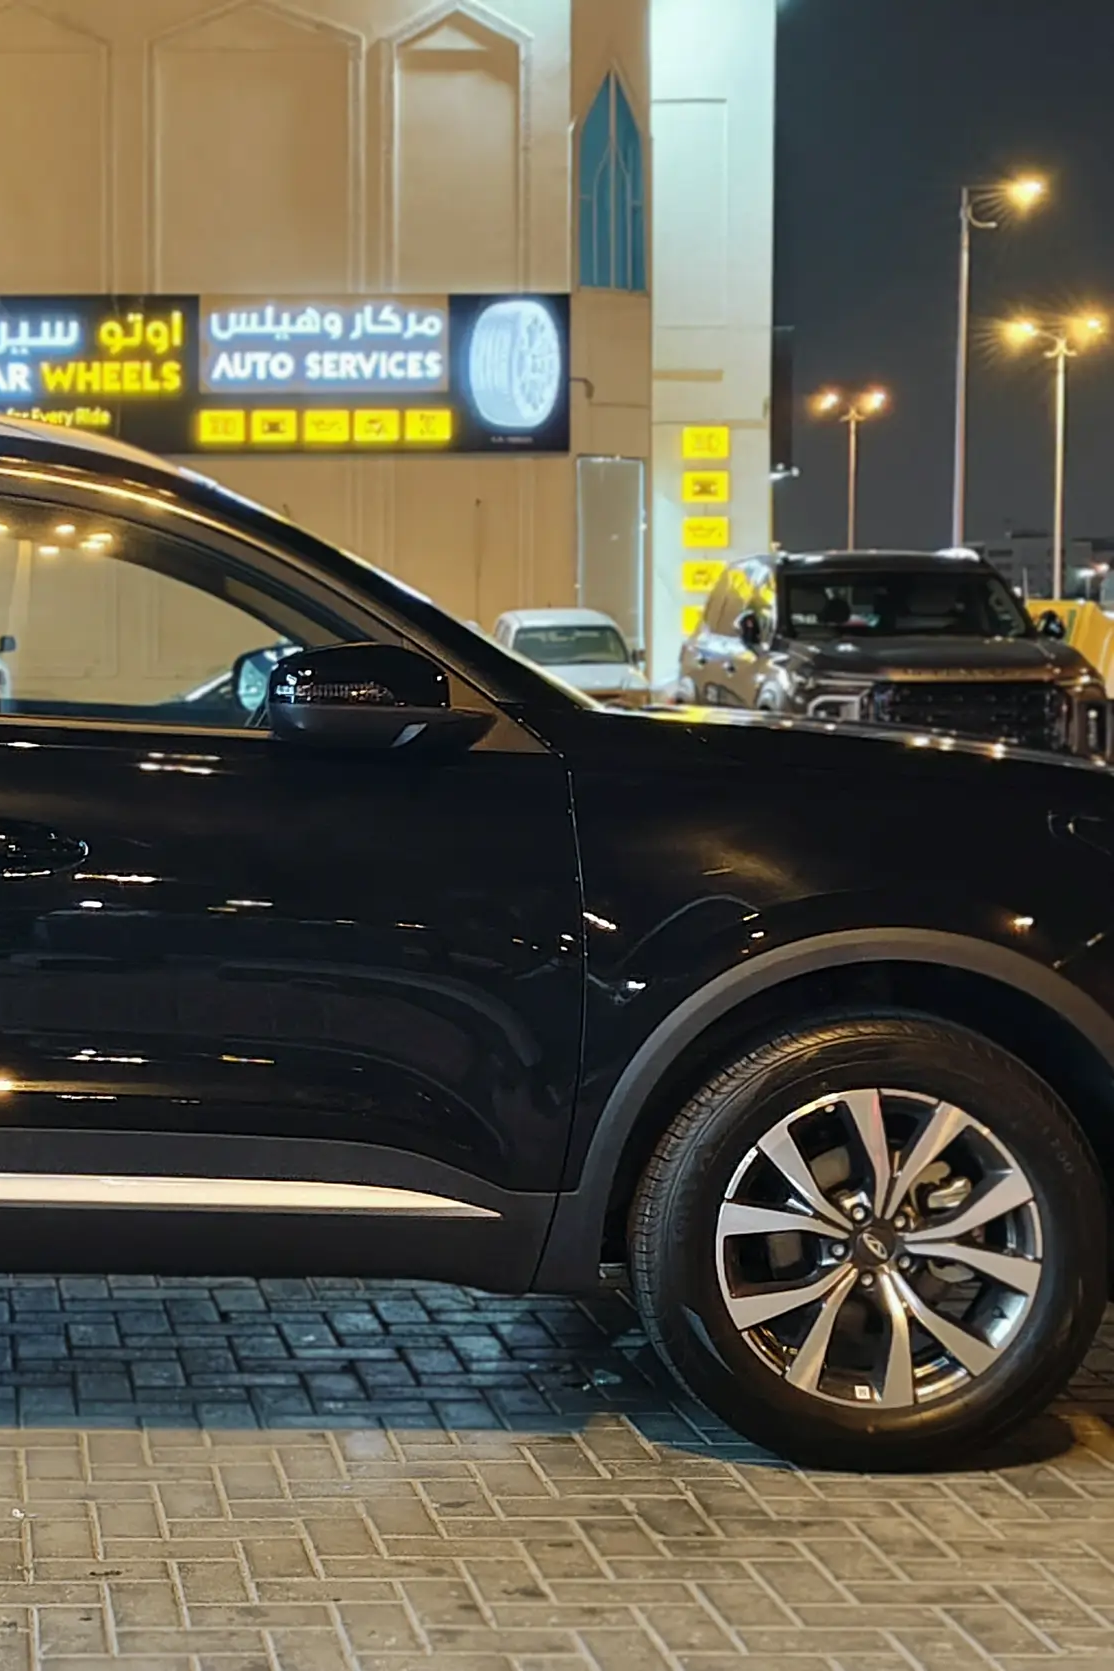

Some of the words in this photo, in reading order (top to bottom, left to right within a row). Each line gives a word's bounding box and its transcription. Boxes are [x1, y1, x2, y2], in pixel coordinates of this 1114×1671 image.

[40, 361, 182, 391] WHEELS
[210, 351, 296, 380] AUTO
[304, 351, 444, 380] SERVICES
